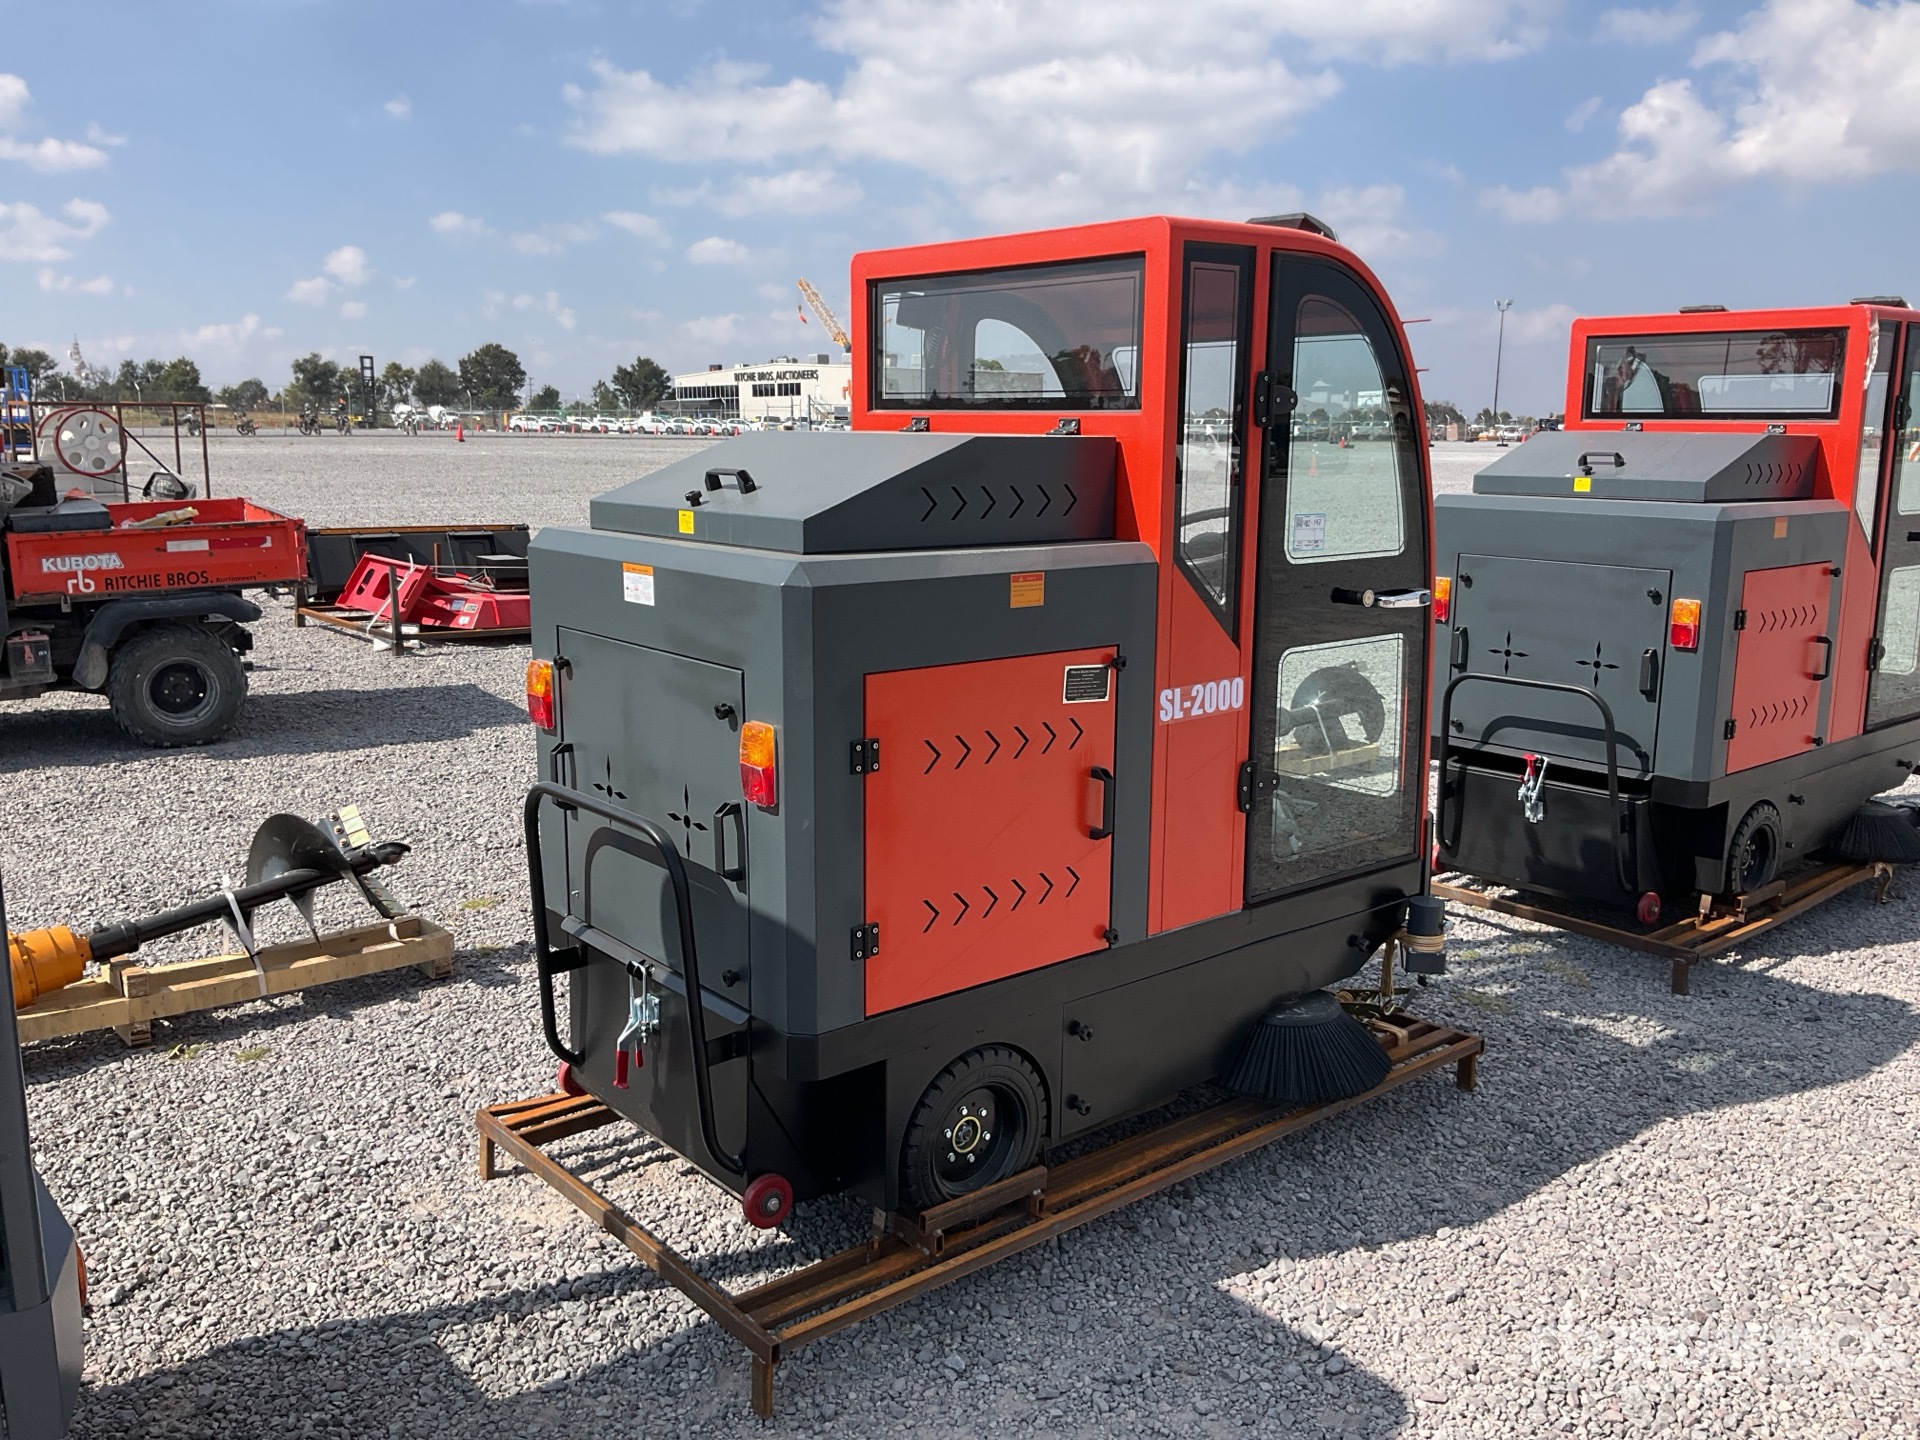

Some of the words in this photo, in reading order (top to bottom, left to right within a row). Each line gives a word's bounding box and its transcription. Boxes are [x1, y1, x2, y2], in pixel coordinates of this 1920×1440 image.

[734, 372, 757, 382] RITCHIE
[776, 369, 819, 381] AUCTIONEERS
[42, 553, 124, 573] KUBOTA
[104, 573, 161, 591] RITCHIE
[167, 571, 214, 585] BROS.
[1159, 677, 1244, 722] SL-2000
